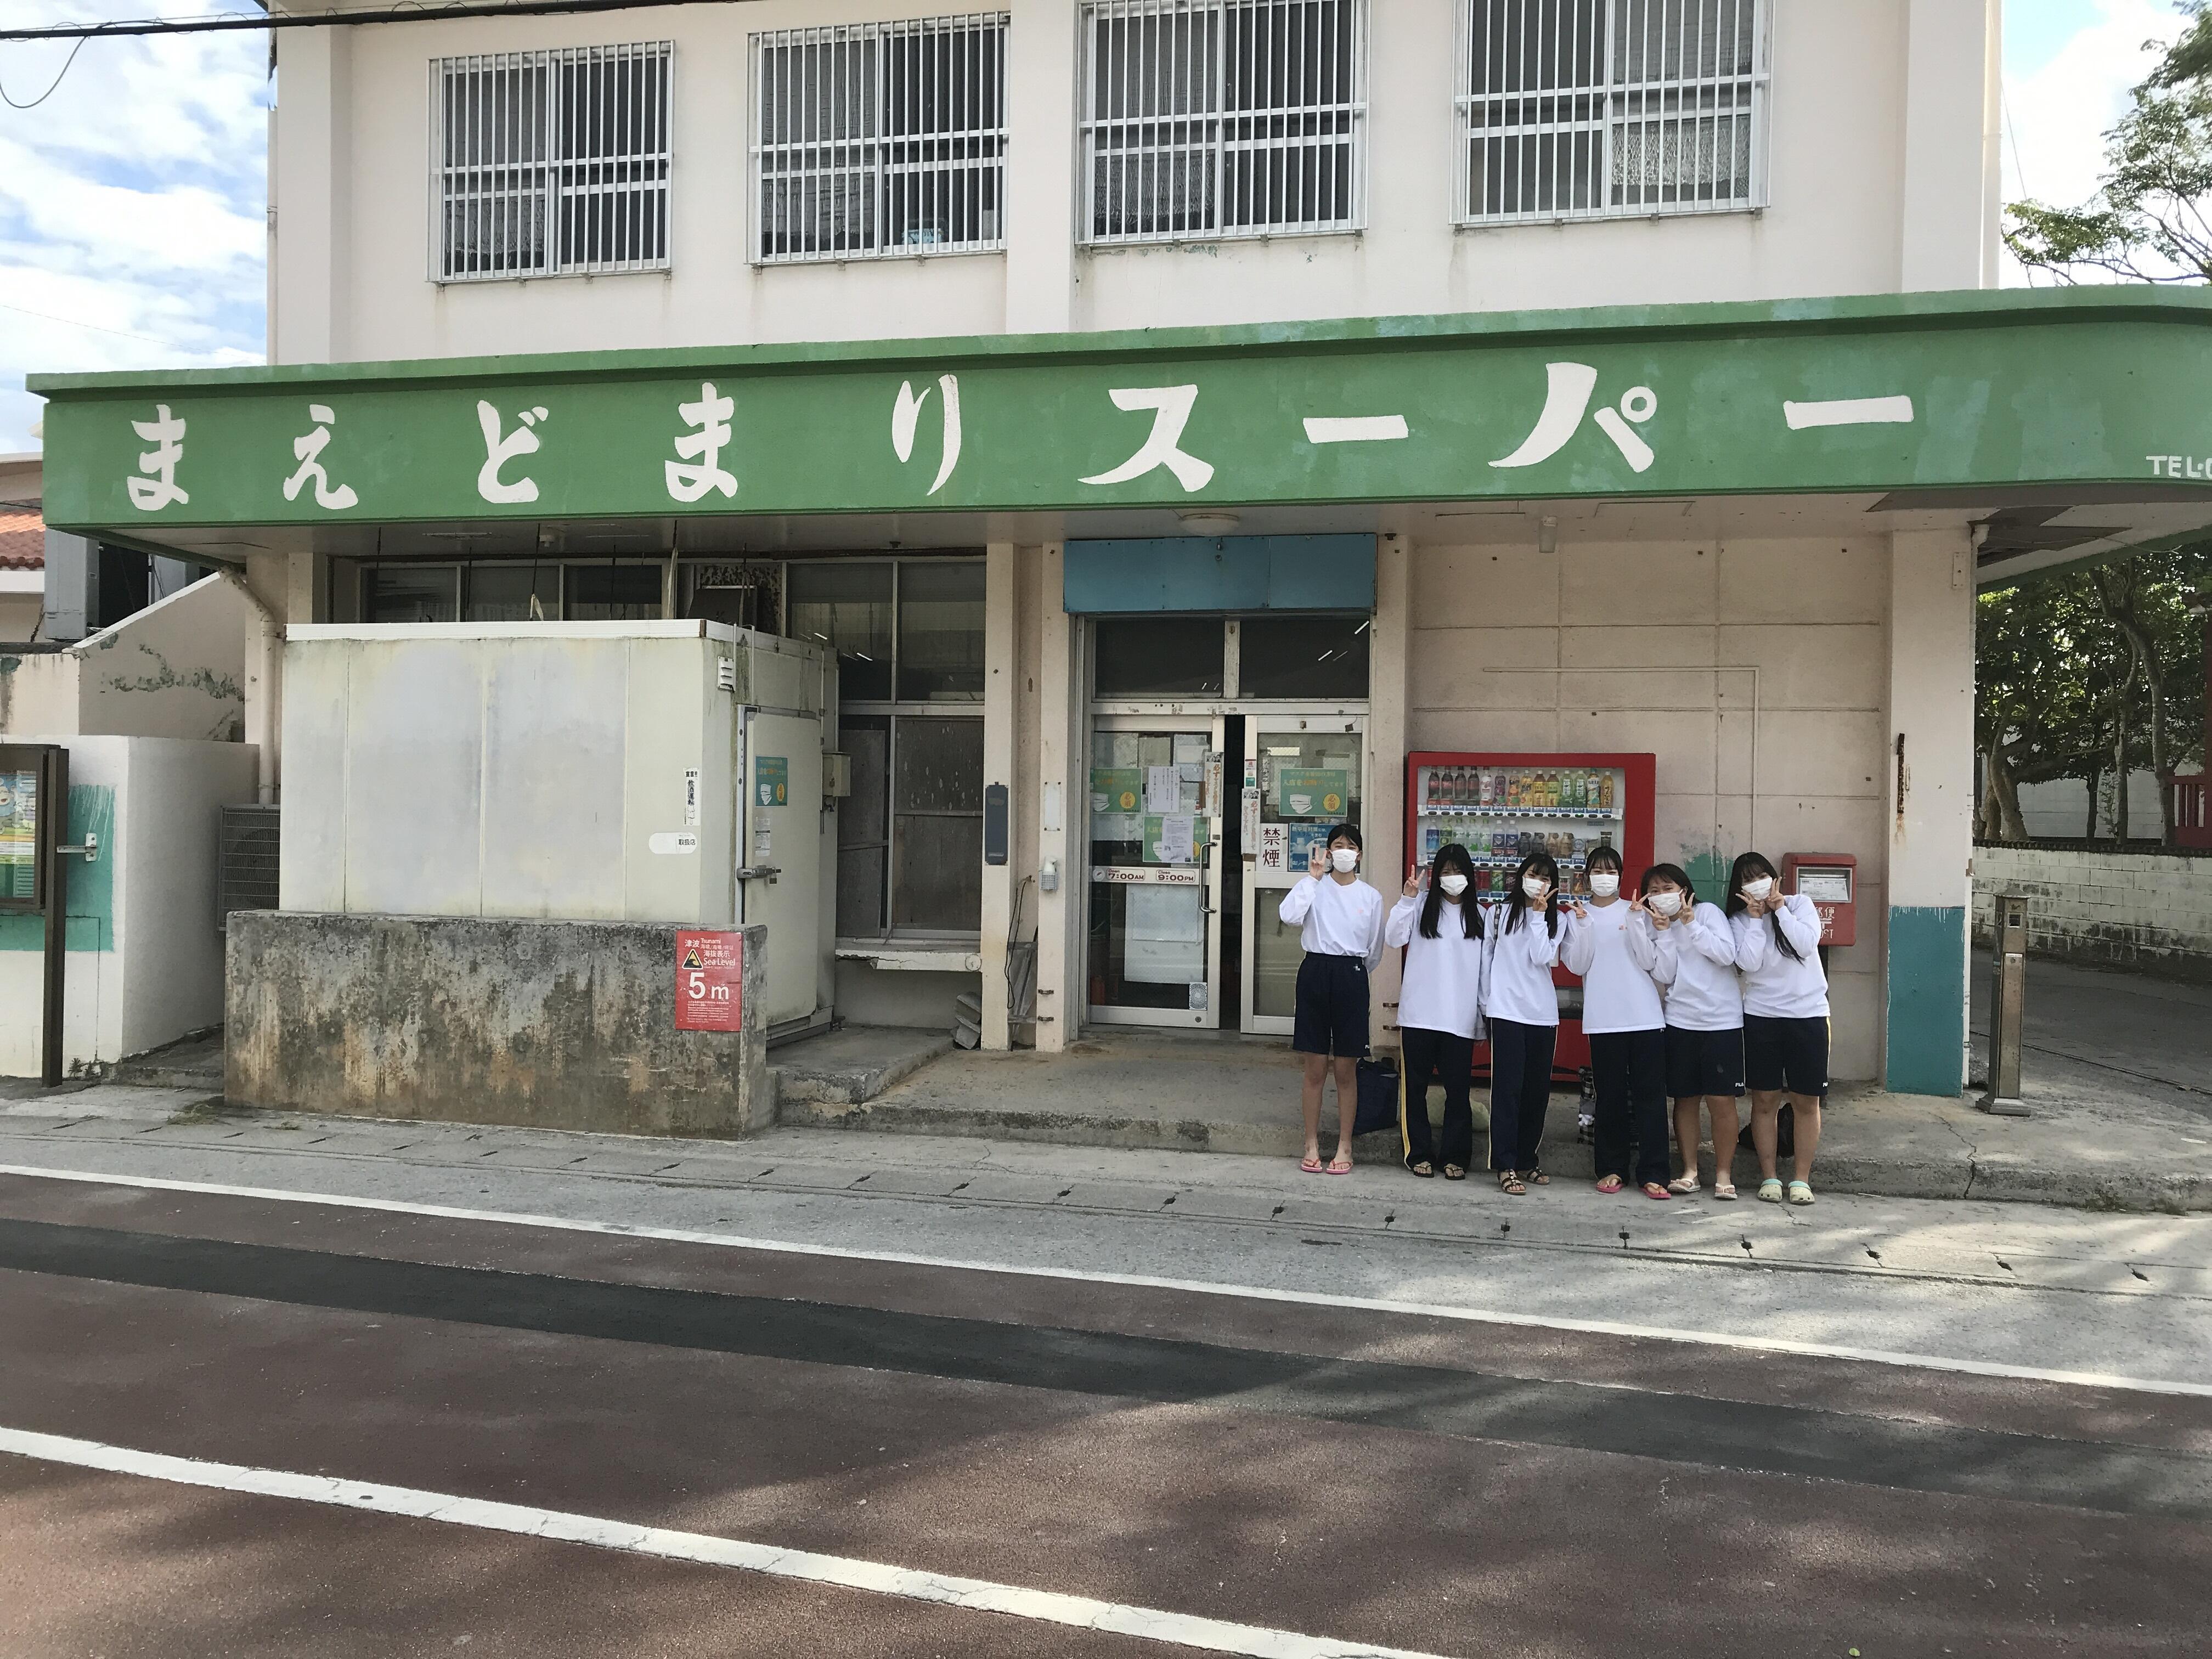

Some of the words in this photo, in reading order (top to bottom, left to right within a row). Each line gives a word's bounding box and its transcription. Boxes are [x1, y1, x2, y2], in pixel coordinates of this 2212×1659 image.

[126, 362, 1915, 511] まえどまりスーパー
[1263, 828, 1280, 867] 禁煙
[685, 939, 699, 947] 津波
[703, 950, 730, 958] 海抜表示
[689, 972, 706, 999] 5
[711, 986, 729, 1000] m
